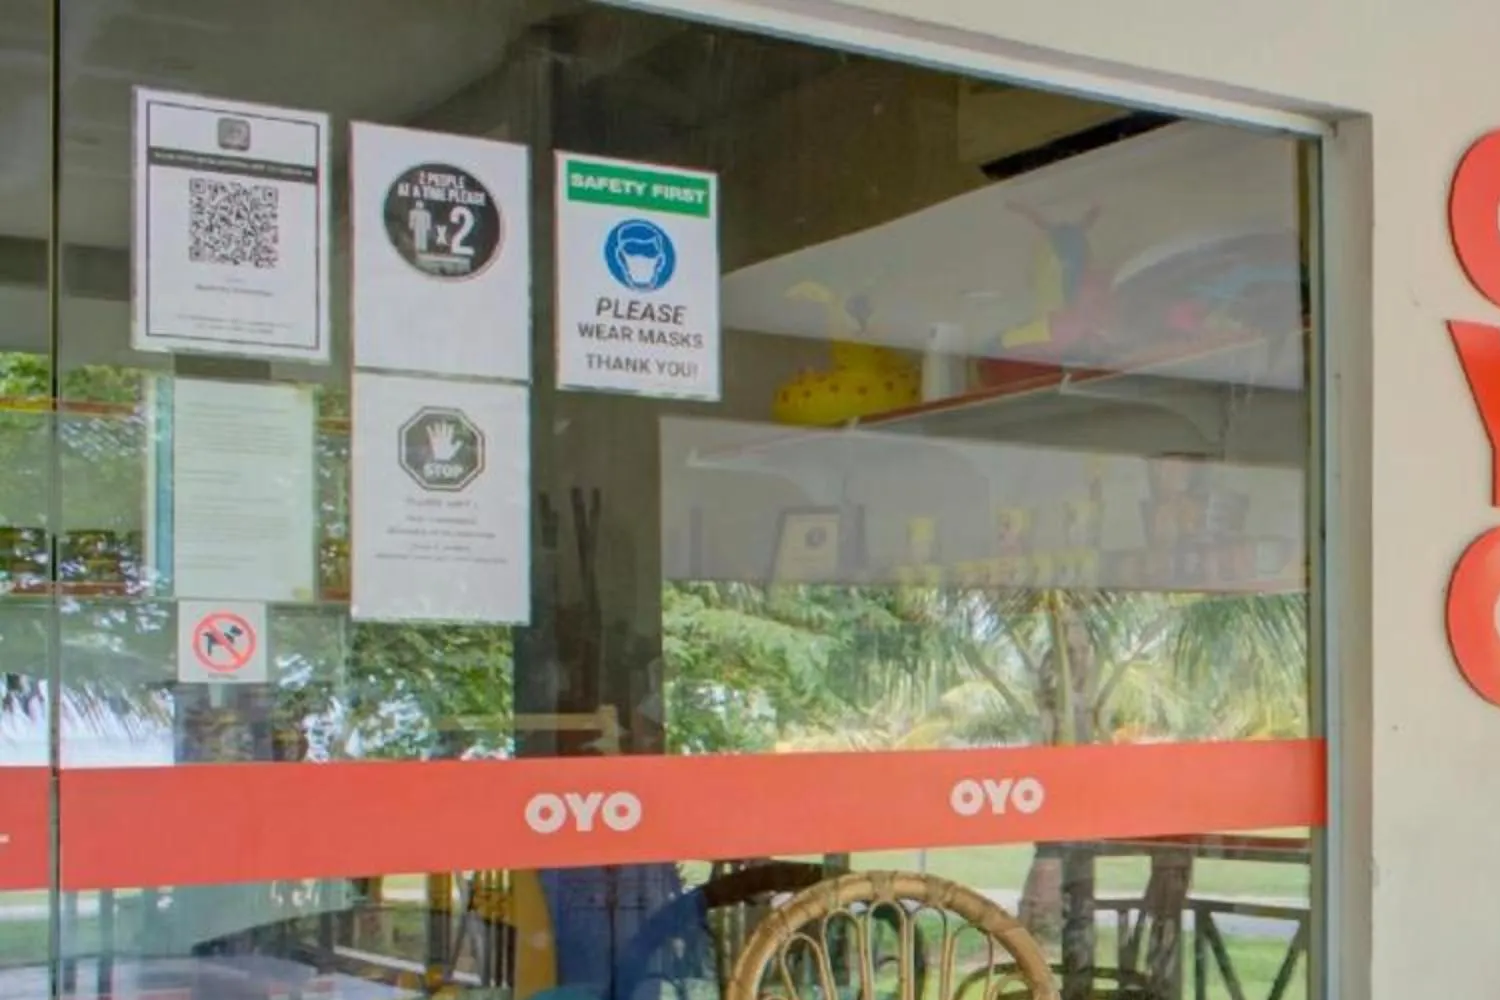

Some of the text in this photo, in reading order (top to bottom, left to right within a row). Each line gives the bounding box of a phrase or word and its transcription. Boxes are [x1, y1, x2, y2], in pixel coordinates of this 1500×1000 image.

[448, 188, 486, 206] PLEASE
[570, 172, 707, 204] SAFETY FIRST
[596, 297, 687, 326] PLEASE
[577, 321, 704, 349] WEAR MASKS
[585, 353, 699, 380] THANK YOU!
[423, 463, 464, 479] STOP
[949, 777, 1045, 816] OYO
[524, 791, 642, 834] OYO
